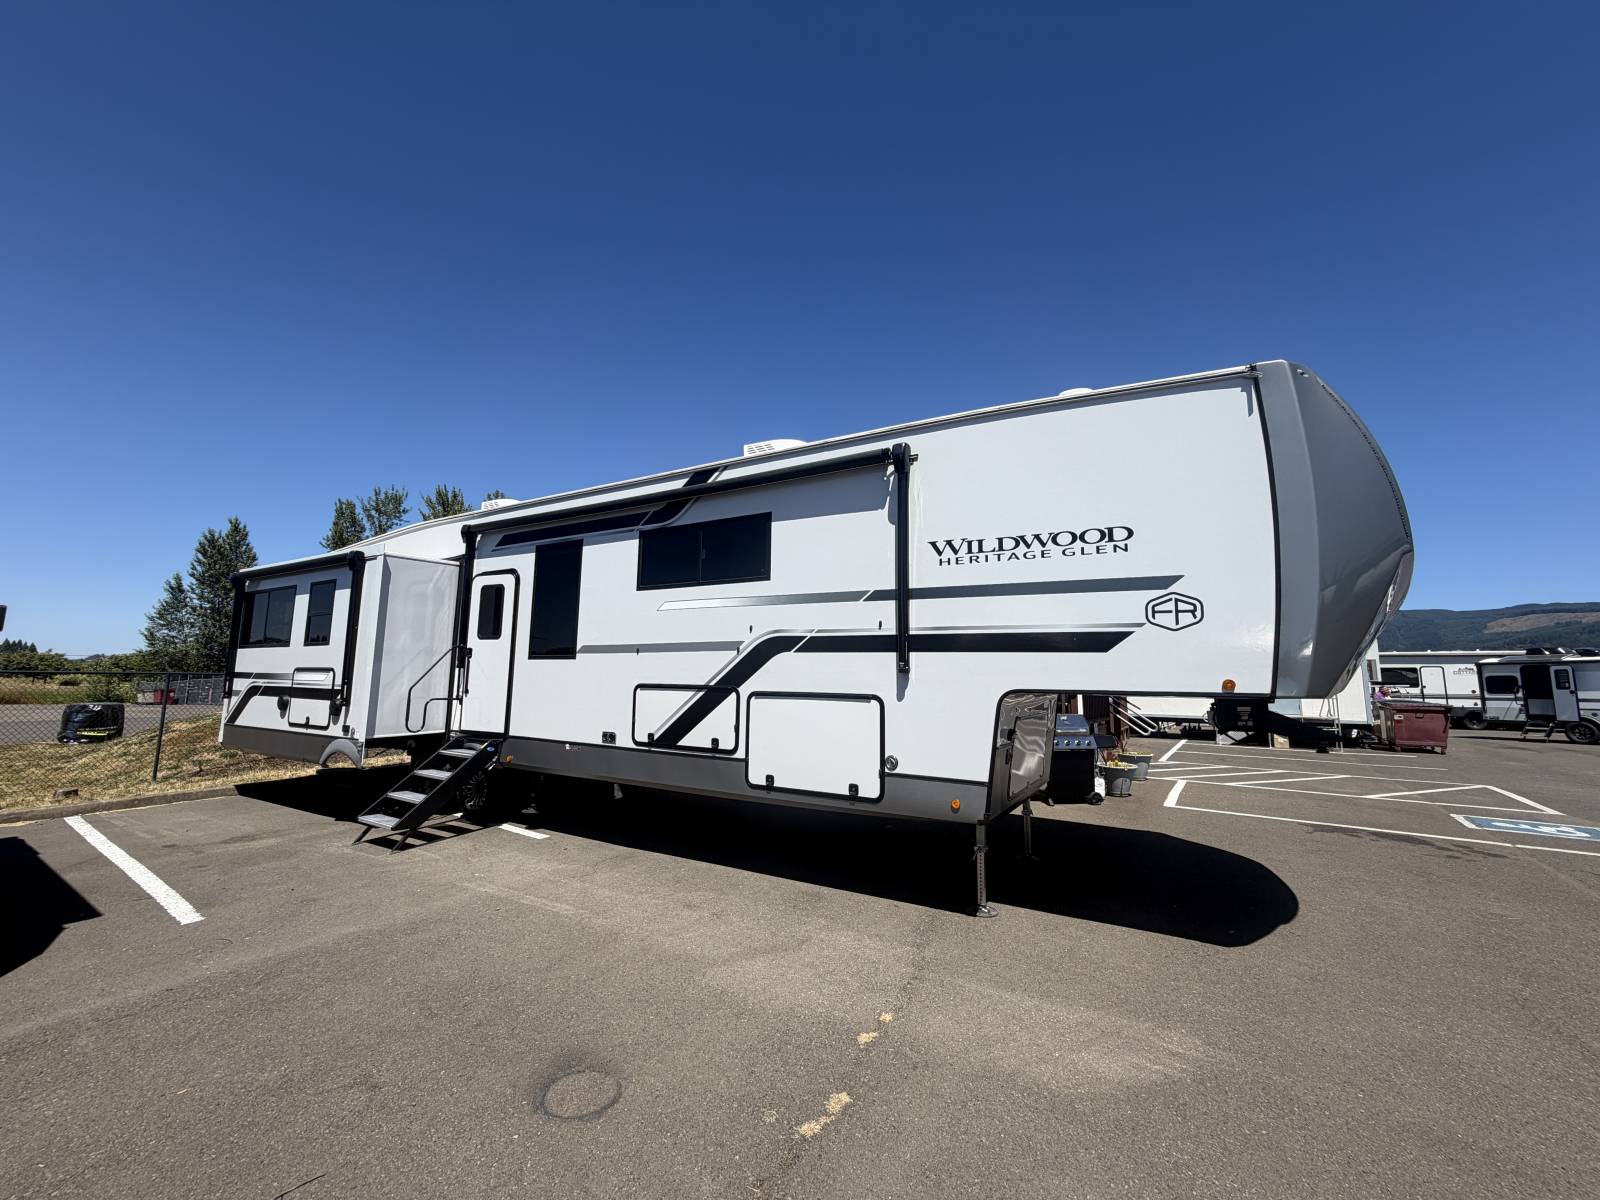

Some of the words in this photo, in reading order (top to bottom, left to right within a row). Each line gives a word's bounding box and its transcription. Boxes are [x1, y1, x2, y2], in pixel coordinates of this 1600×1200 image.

[928, 526, 1134, 557] WILDWOOD
[938, 549, 1052, 566] HERITAGE
[1061, 543, 1129, 557] GLEN
